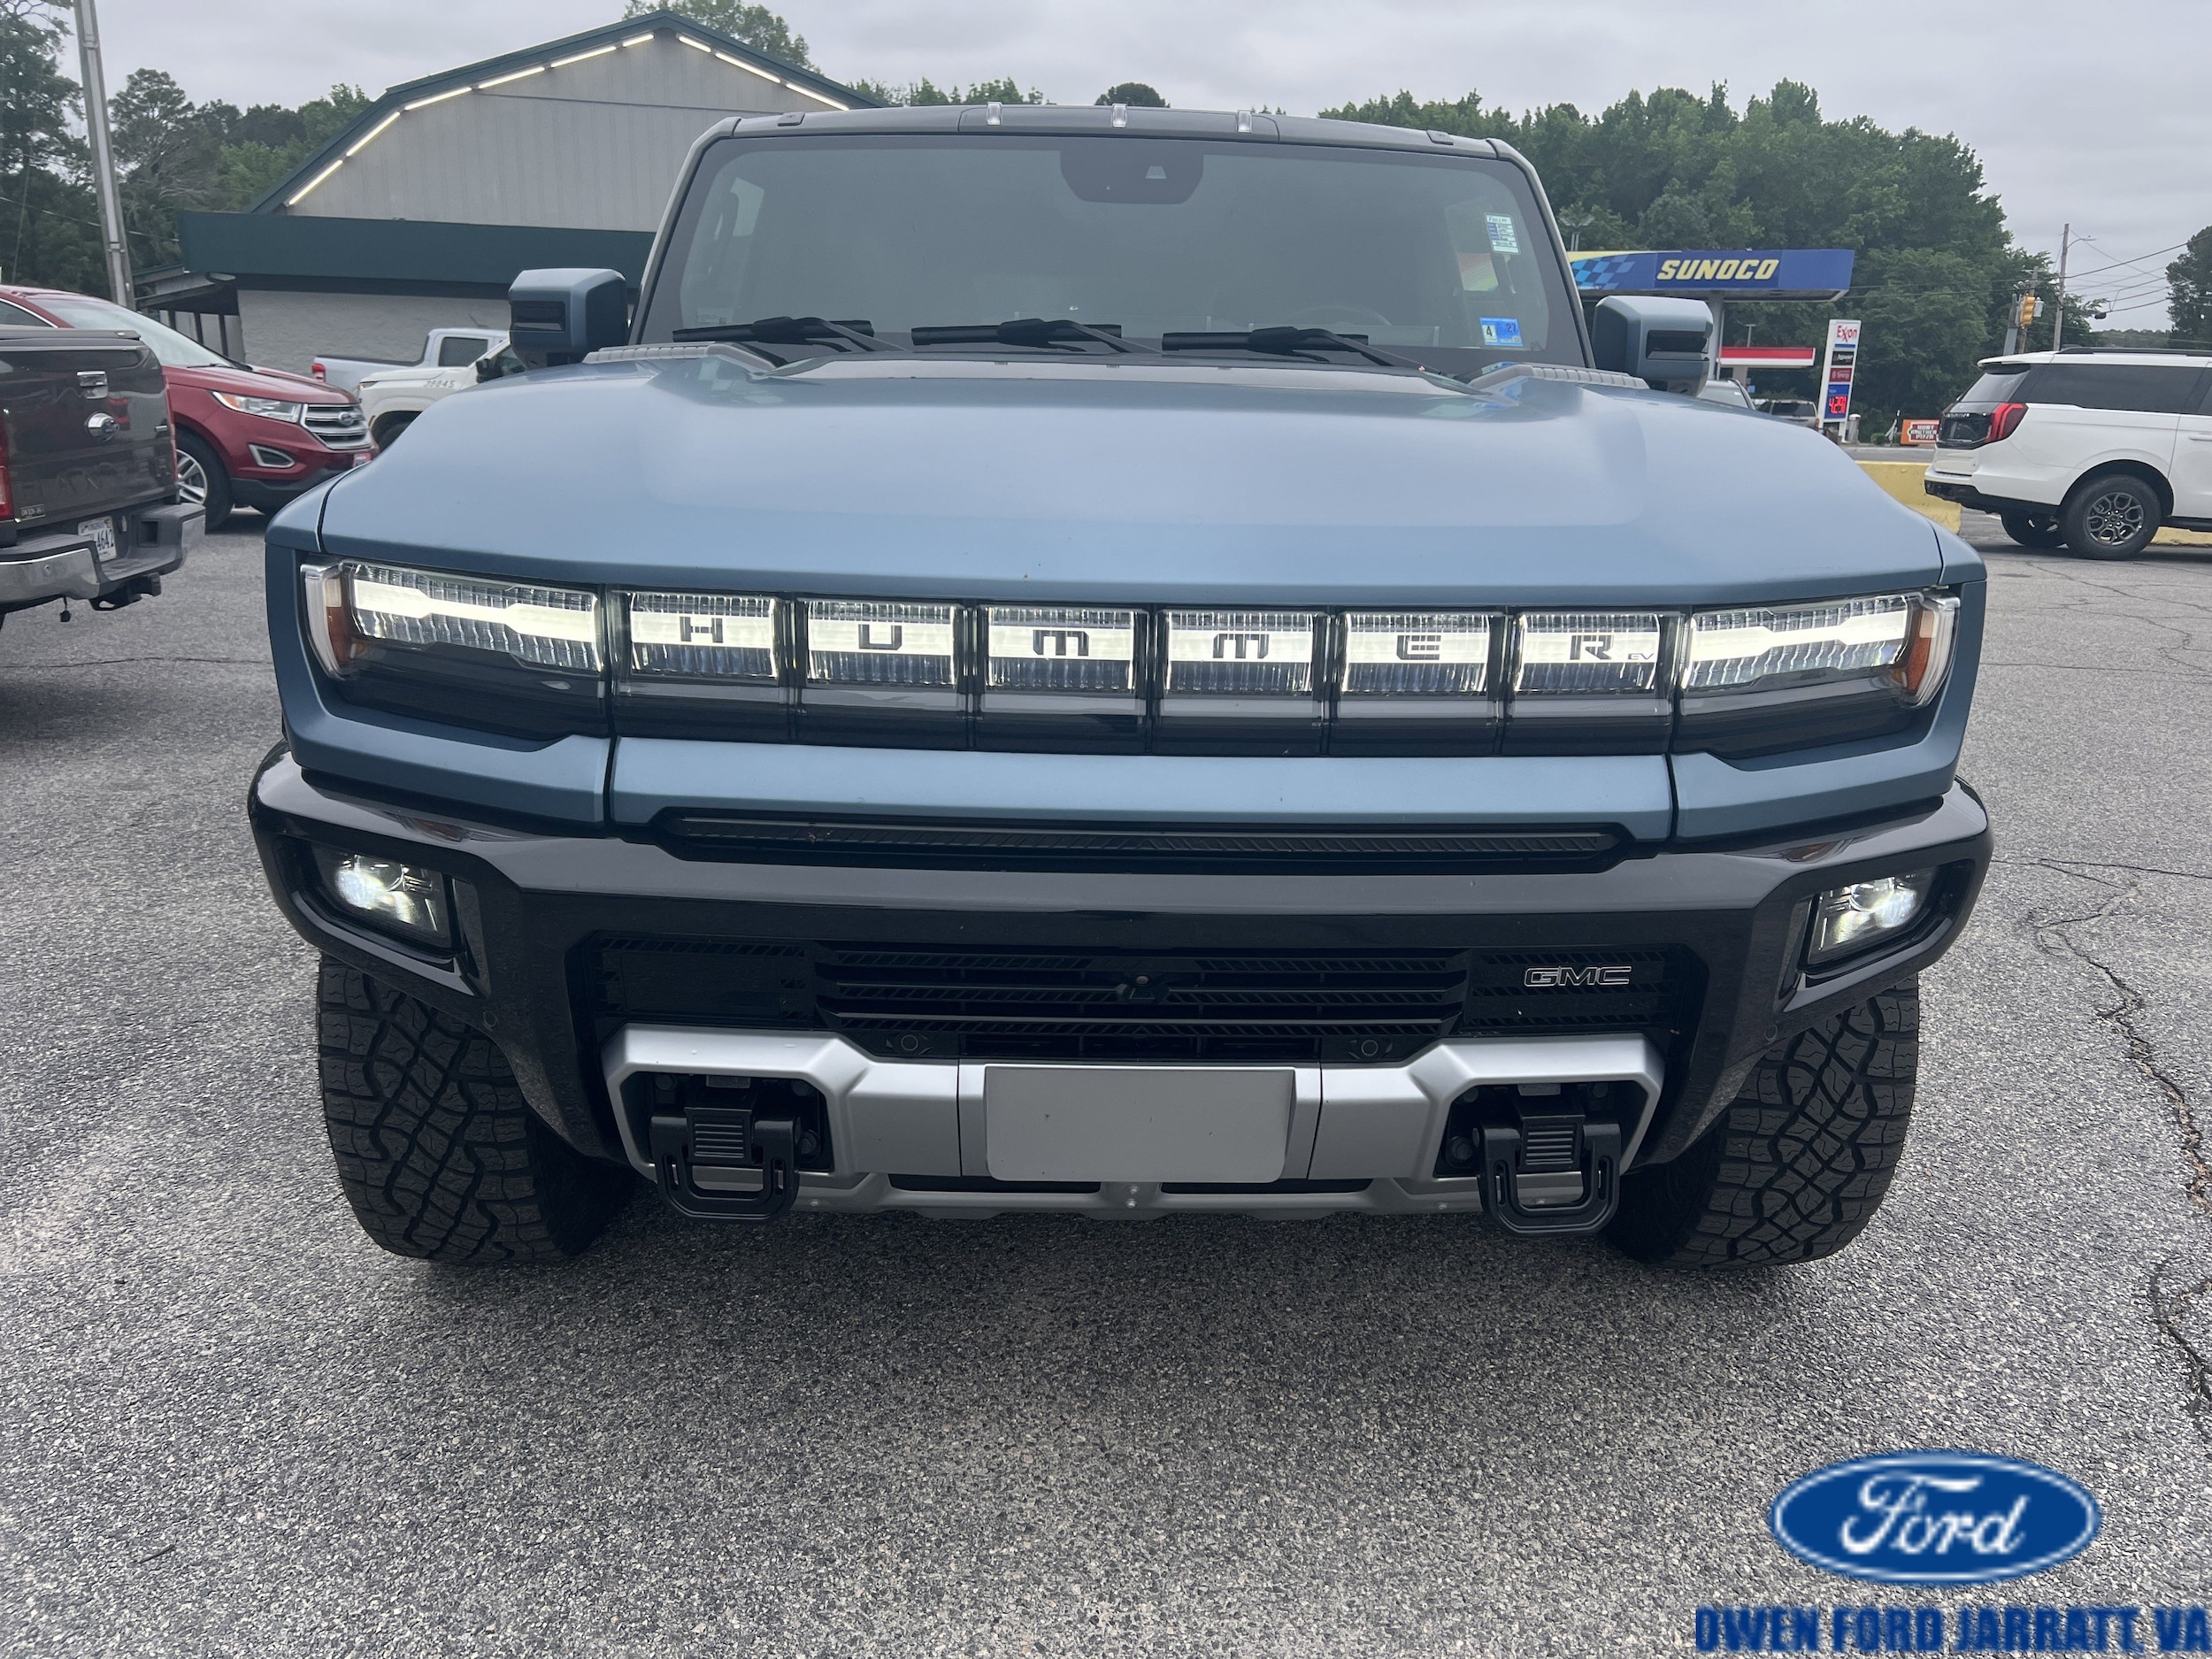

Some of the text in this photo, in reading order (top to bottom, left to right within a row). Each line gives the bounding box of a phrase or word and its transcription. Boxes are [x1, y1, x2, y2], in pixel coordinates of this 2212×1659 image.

[1656, 259, 1779, 280] SUNOCO
[1486, 325, 1493, 337] 4
[1836, 325, 1858, 342] Exxon
[1626, 652, 1655, 661] EV
[1525, 965, 1632, 987] GMC
